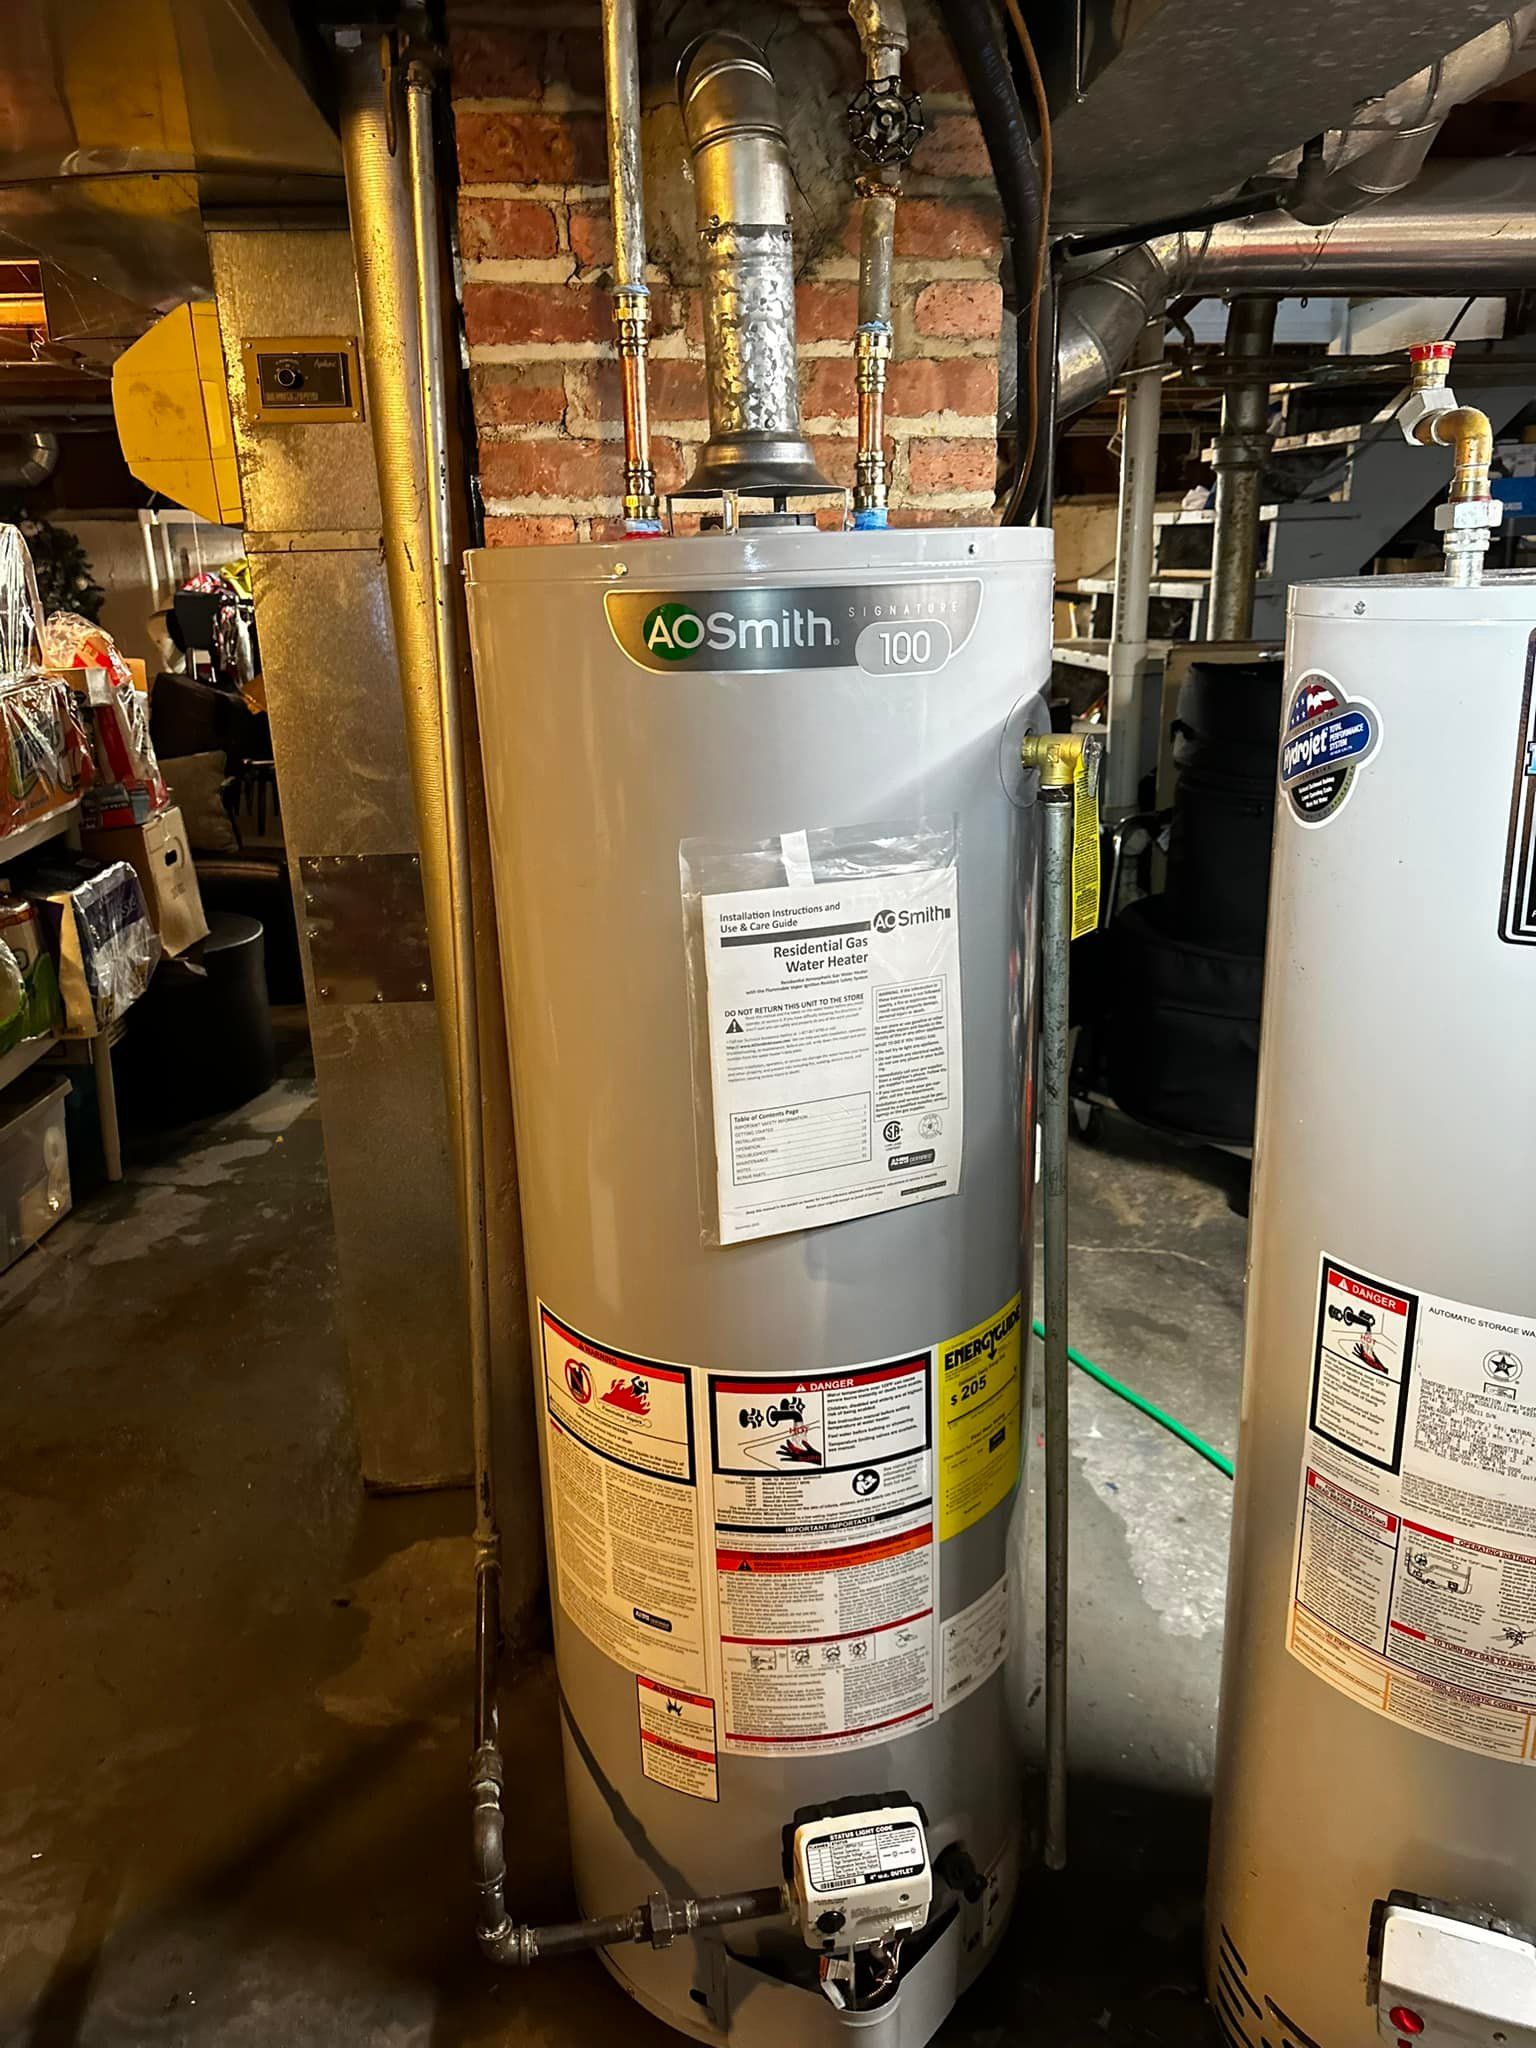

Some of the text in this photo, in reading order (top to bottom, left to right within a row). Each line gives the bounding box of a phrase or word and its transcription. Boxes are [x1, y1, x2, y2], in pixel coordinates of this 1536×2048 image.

[848, 602, 960, 617] SIGNATURE
[878, 629, 931, 666] 100
[1283, 727, 1329, 774] Hydrojet
[719, 910, 770, 922] Installation
[772, 904, 823, 918] Instructions
[772, 918, 798, 930] Guide
[774, 937, 868, 958] Residential Gas
[786, 952, 868, 973] Water Heater
[737, 1008, 753, 1017] NOT
[755, 1004, 783, 1015] RETURN
[784, 1002, 800, 1011] THIS
[801, 1000, 818, 1009] UNIT
[819, 998, 829, 1006] TO
[830, 996, 842, 1004] THE
[843, 993, 864, 1002] STORE
[758, 1111, 784, 1120] Contents
[785, 1108, 799, 1116] Page
[1352, 1284, 1397, 1310] DANGER
[1429, 1307, 1477, 1325] AUTOMATIC
[1478, 1320, 1520, 1335] STORAGE
[1360, 1334, 1377, 1345] HOT
[810, 1378, 855, 1391] DANGER
[961, 1374, 987, 1402] 205
[1330, 1492, 1351, 1508] BEFORE
[1352, 1506, 1386, 1526] OPERATING
[1336, 1490, 1352, 1502] YOUR
[1353, 1498, 1376, 1515] SAFETY
[1458, 1540, 1500, 1557] OPERATING
[1434, 1638, 1443, 1646] TO
[1444, 1641, 1462, 1653] TURN
[1464, 1648, 1478, 1657] OFF
[1479, 1652, 1494, 1662] GAS
[830, 1825, 893, 1841] STATUS LIGHT CODE
[891, 1867, 914, 1877] OUTLET
